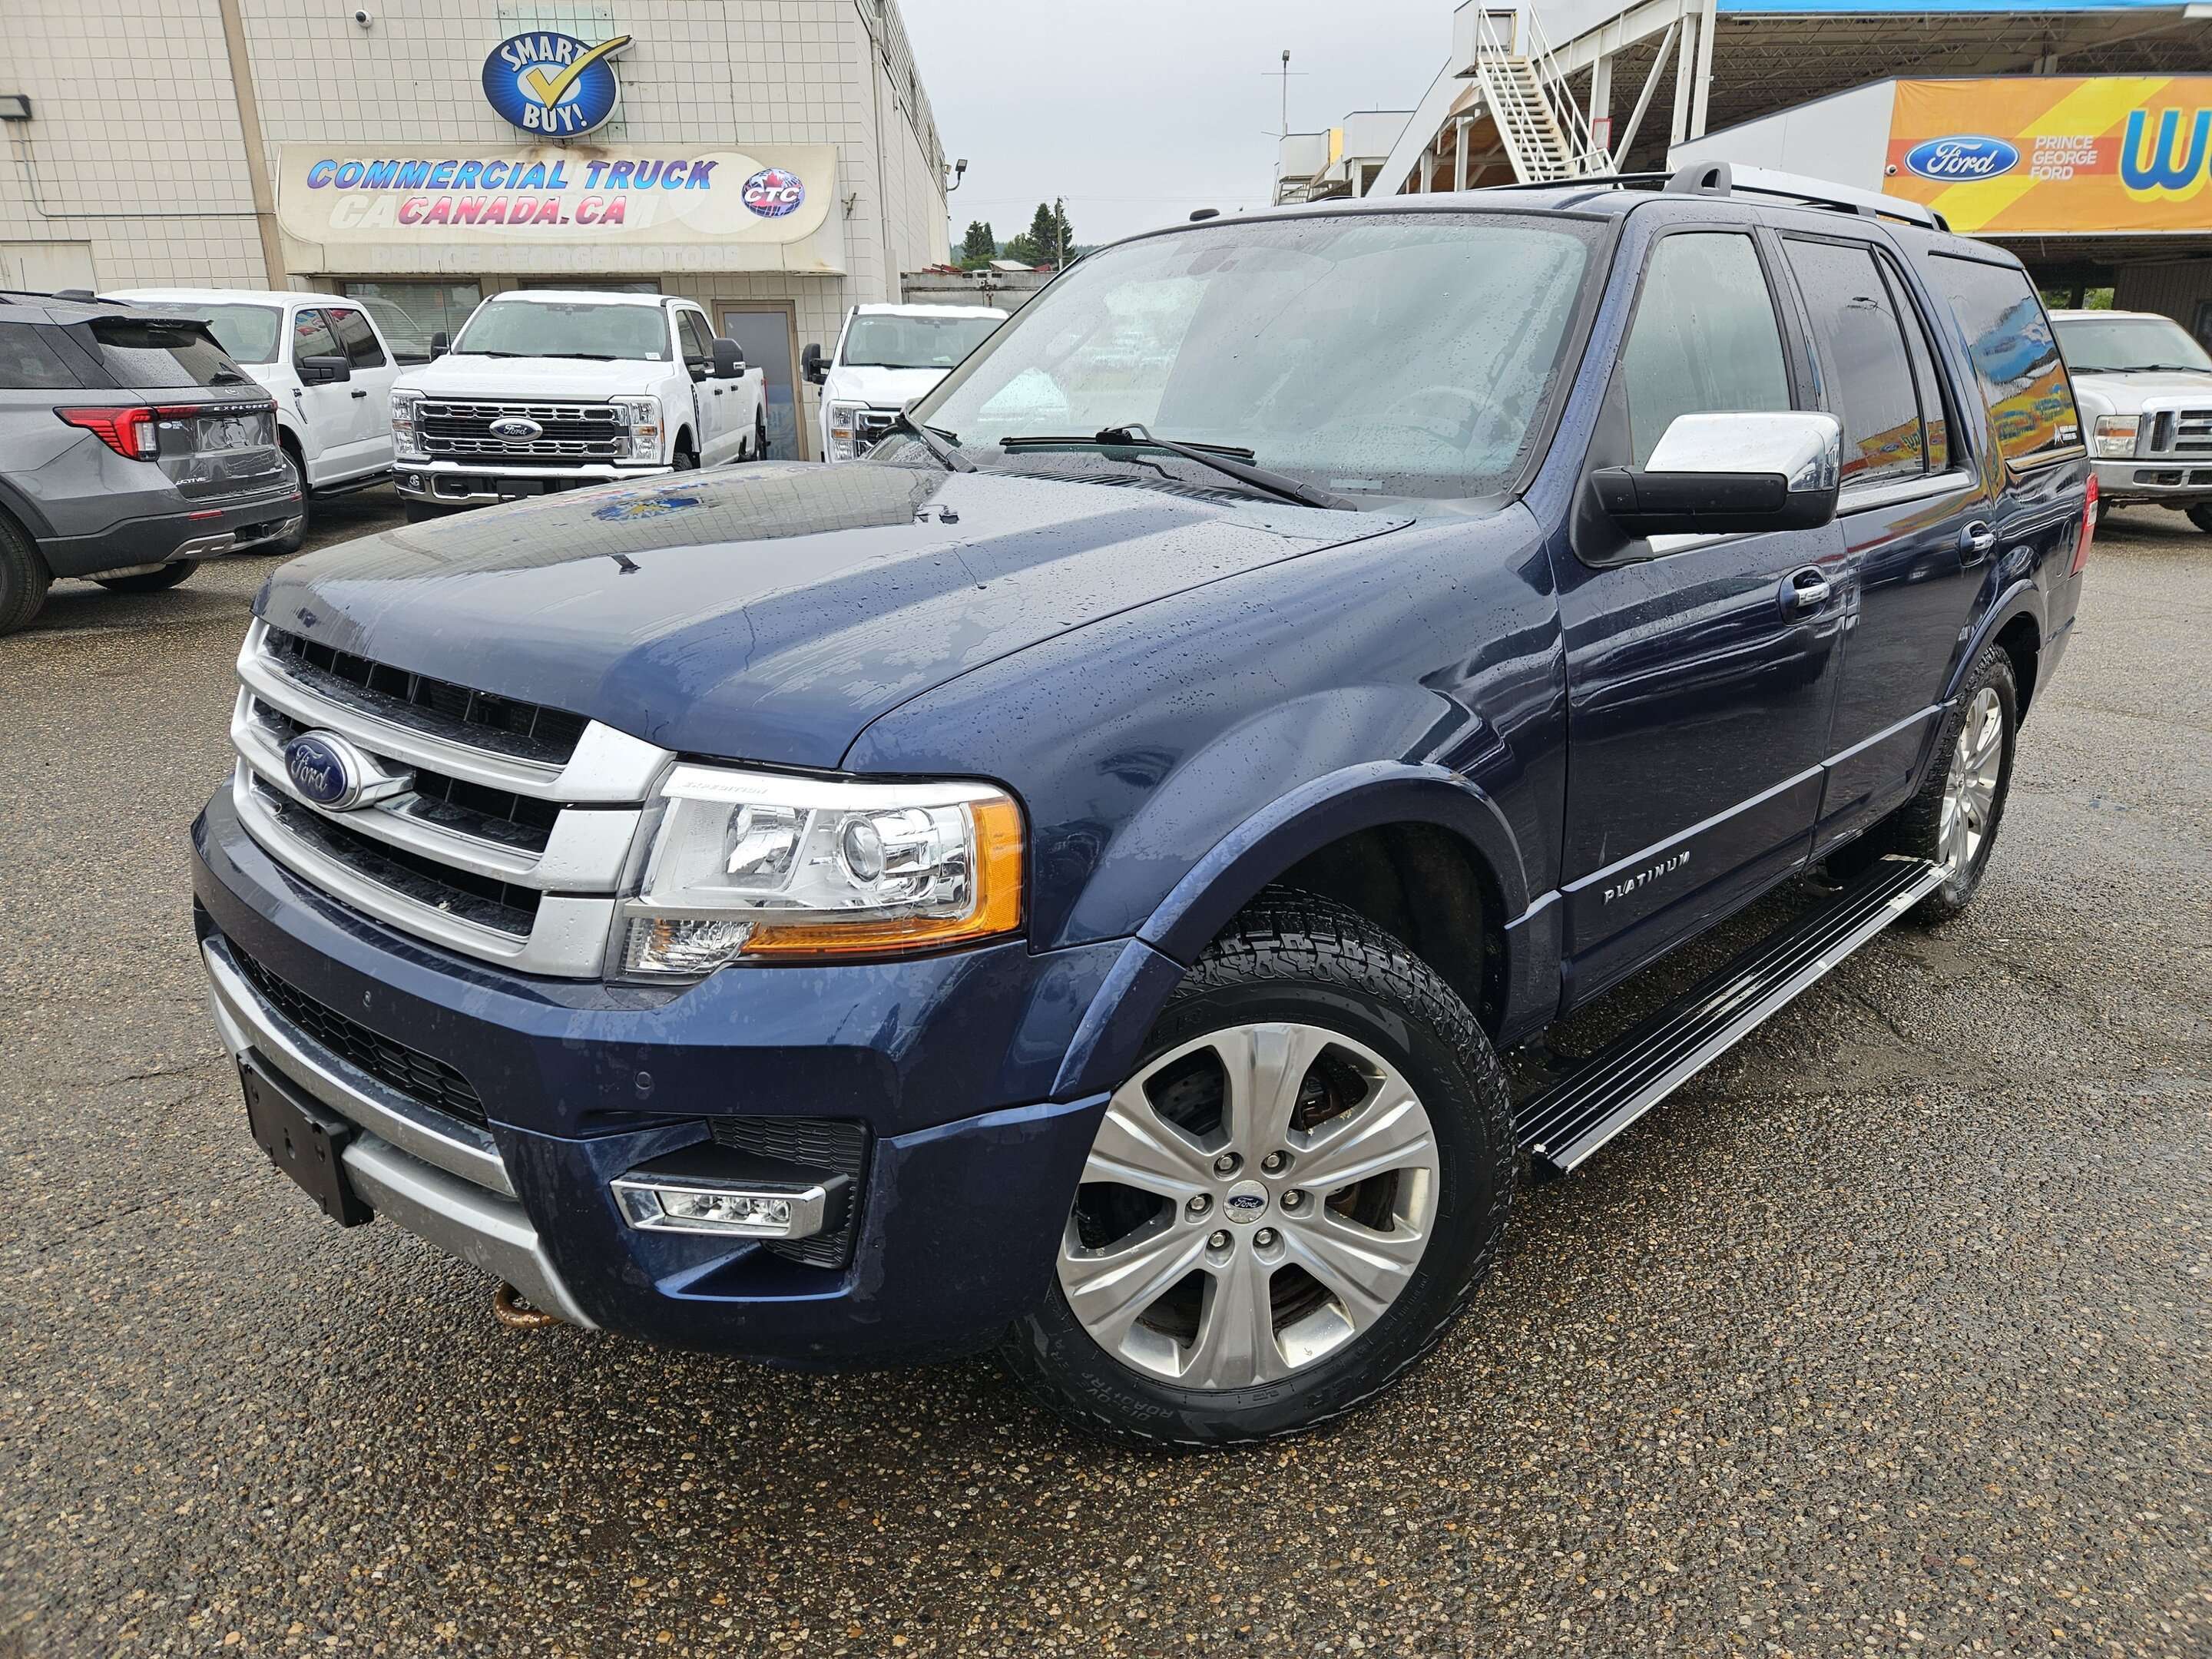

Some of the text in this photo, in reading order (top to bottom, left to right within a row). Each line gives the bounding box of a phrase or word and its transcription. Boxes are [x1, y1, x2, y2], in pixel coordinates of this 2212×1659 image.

[501, 36, 589, 72] SMART
[523, 103, 588, 132] BUY!
[2035, 134, 2094, 149] PRINCE
[1926, 140, 1999, 174] Ford
[2032, 151, 2098, 165] GEORGE
[307, 159, 719, 190] COMMERCIAL TRUCK
[2030, 166, 2074, 180] FORD
[398, 196, 627, 225] CANADA.CA
[503, 424, 528, 436] Ford
[291, 744, 331, 792] Ford
[1603, 850, 1690, 905] PLATINUM
[1234, 1197, 1260, 1208] Ford
